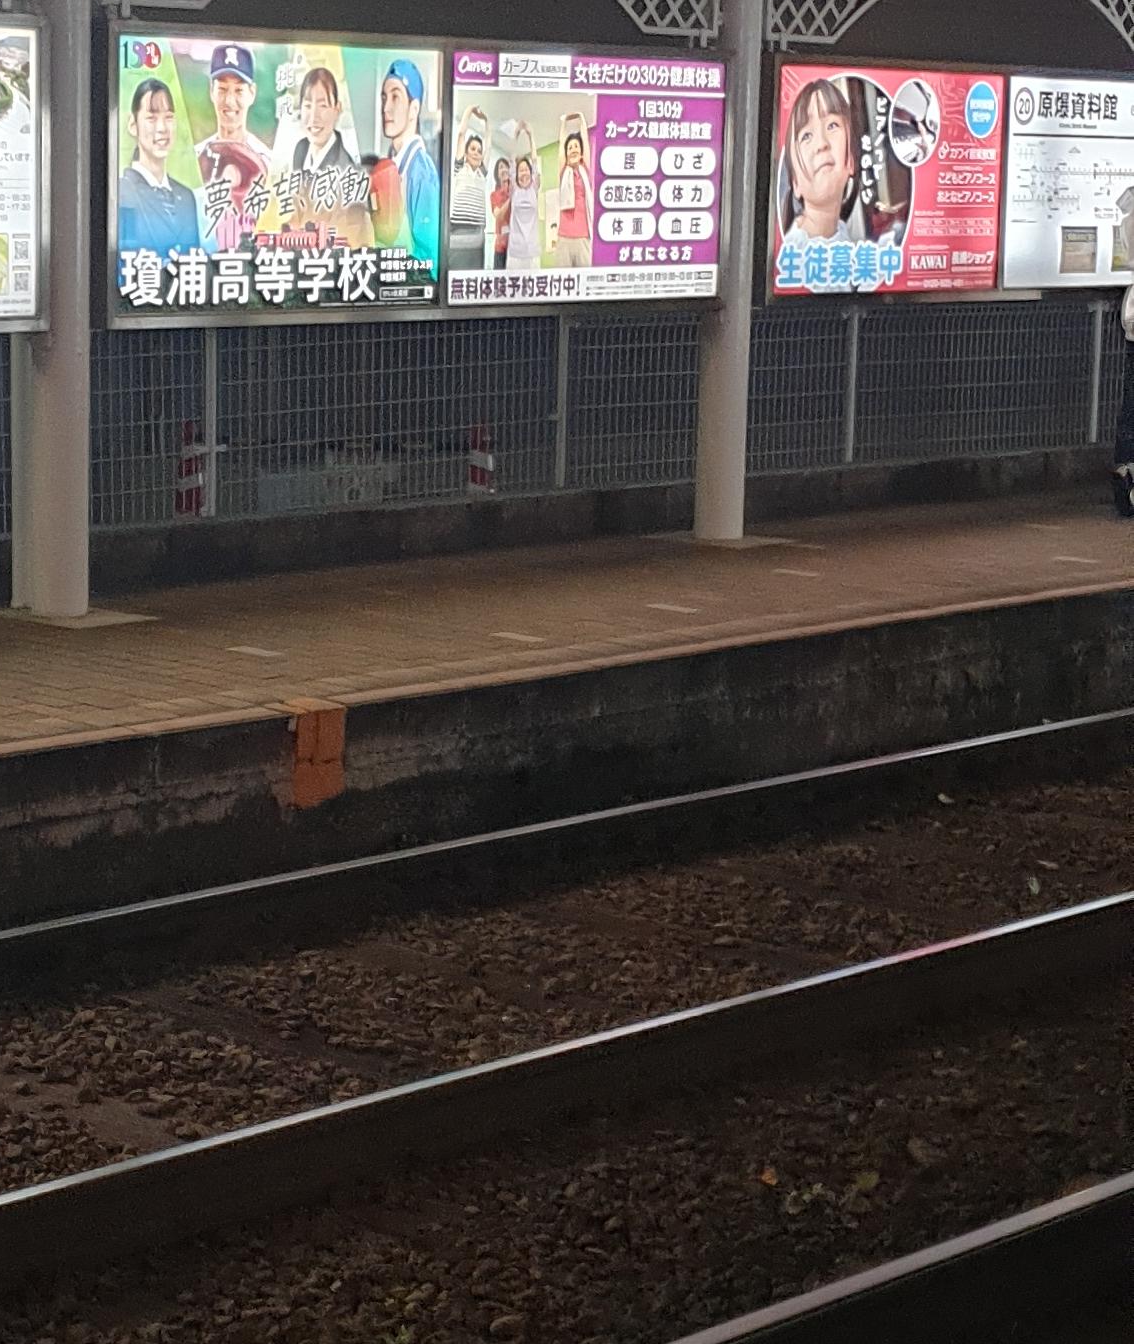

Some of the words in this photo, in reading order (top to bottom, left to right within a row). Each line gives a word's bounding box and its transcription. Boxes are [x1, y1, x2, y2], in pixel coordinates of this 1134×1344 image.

[574, 62, 721, 89] 女性だけの30分健康体操
[638, 100, 683, 119] 1回30分
[1037, 91, 1119, 121] 原爆資料館
[674, 152, 704, 170] ひざ
[672, 185, 703, 203] 体力
[619, 246, 693, 262] が気になる方
[911, 255, 947, 270] KAWAI
[777, 244, 903, 286] 生徒募集中
[120, 247, 377, 306] 瓊浦高等学校
